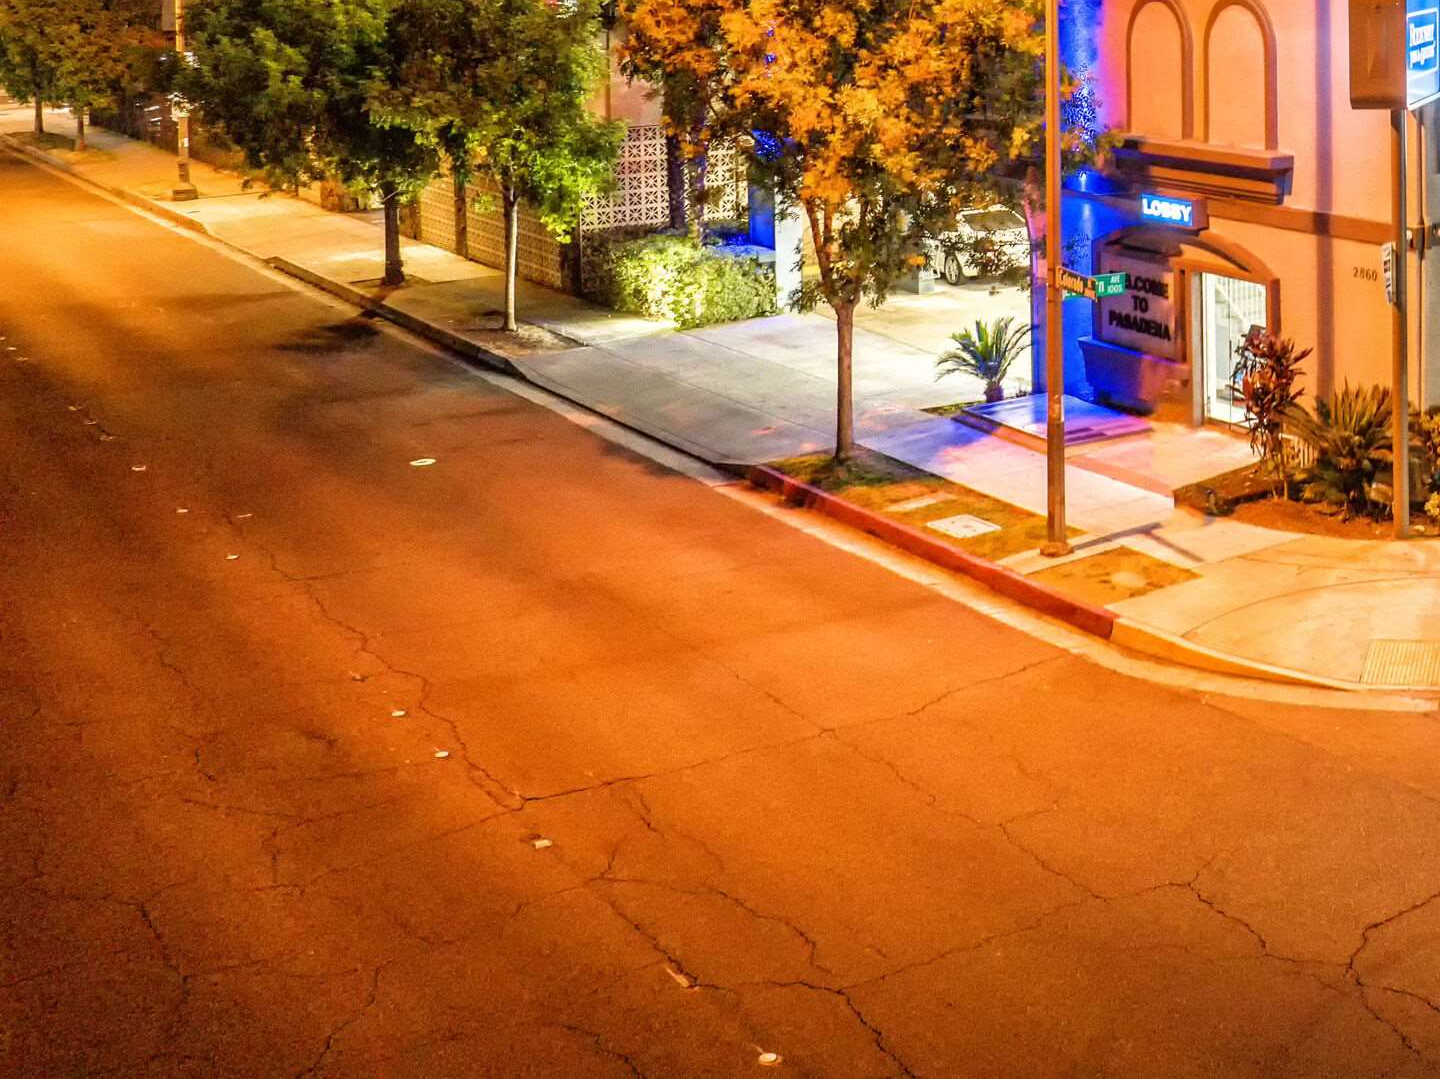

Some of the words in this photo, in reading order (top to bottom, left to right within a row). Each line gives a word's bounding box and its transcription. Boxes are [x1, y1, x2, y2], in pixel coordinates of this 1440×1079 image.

[1143, 198, 1192, 222] LOBBY
[1352, 266, 1378, 281] 2860
[1131, 295, 1149, 313] TO
[1108, 310, 1171, 341] PASADENA
